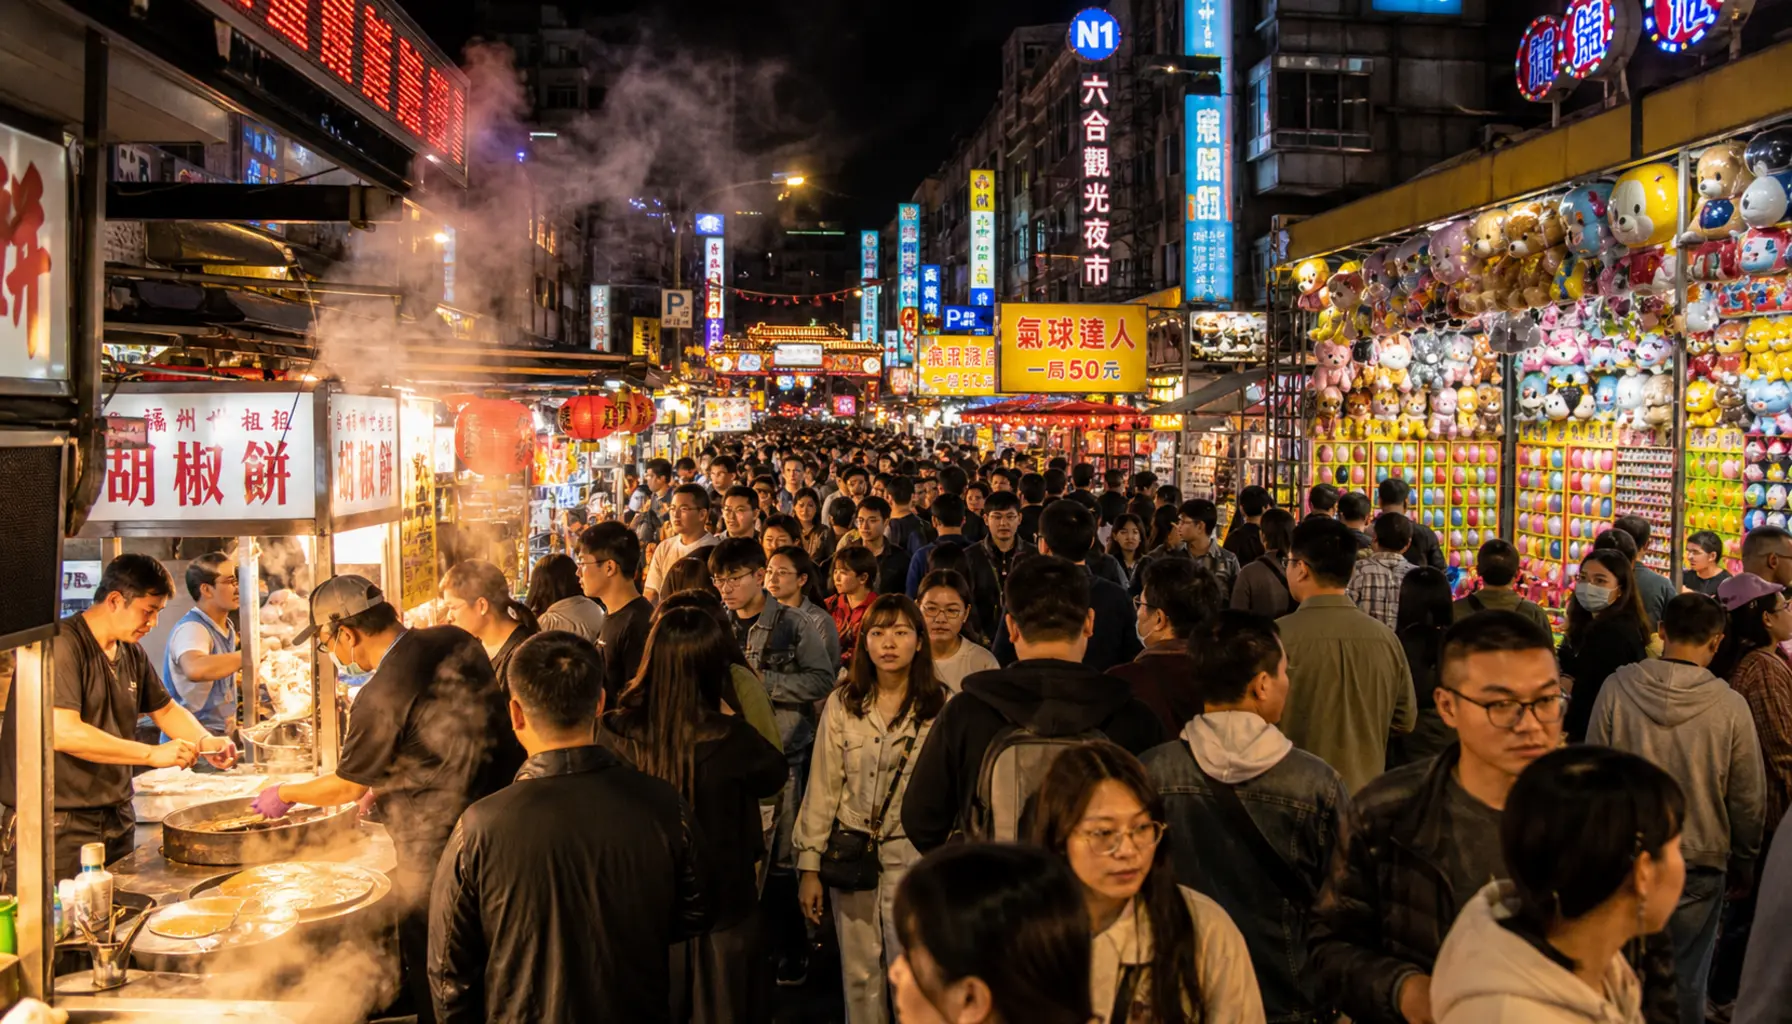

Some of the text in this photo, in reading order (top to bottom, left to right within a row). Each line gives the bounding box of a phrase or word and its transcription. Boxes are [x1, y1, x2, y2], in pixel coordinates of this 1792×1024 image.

[1076, 20, 1114, 49] N1
[1083, 75, 1111, 286] 六合觀光夜市
[667, 292, 685, 315] P
[946, 309, 961, 328] P
[1016, 316, 1136, 351] 氣球達人
[1027, 359, 1121, 381] 一局50元
[106, 440, 292, 507] 胡椒餅
